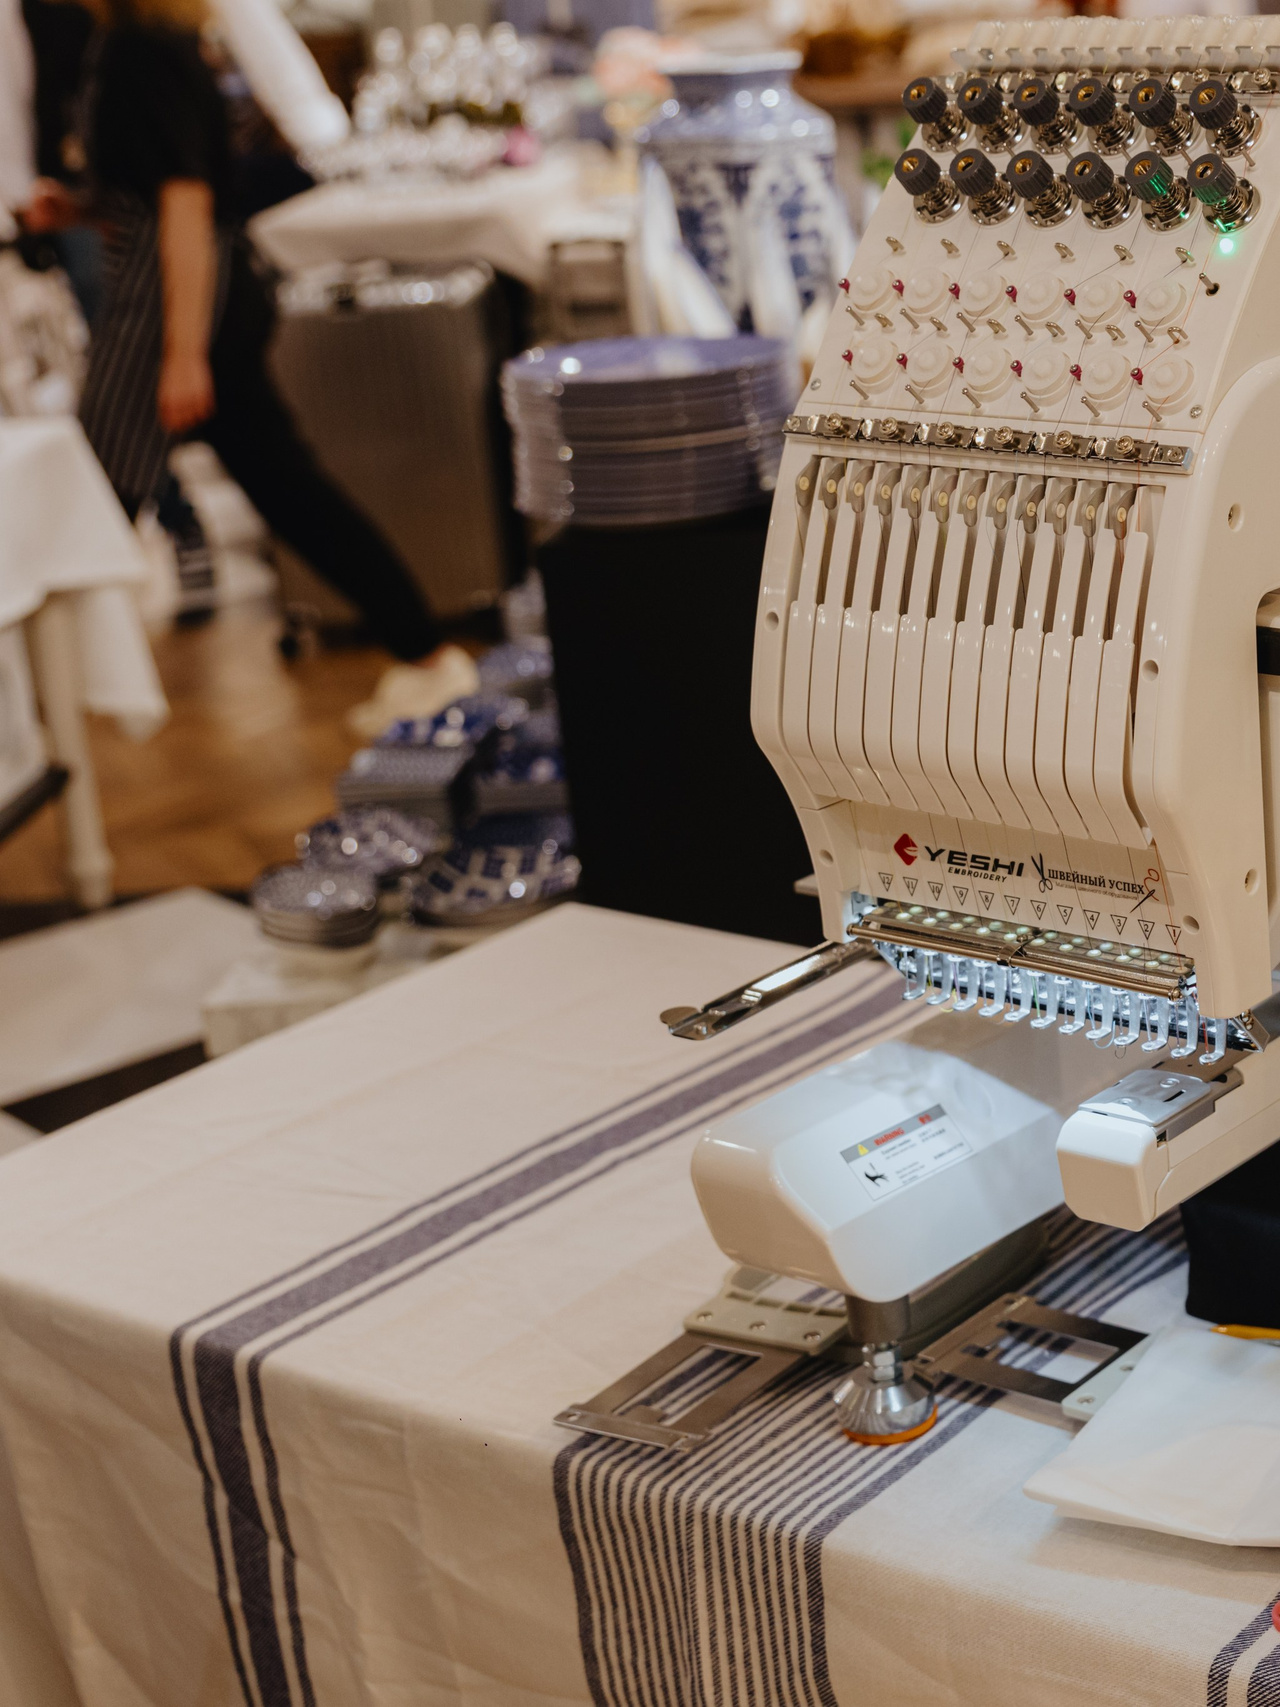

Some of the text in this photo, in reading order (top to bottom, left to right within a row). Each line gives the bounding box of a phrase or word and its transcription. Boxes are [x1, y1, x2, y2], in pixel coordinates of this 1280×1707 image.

[924, 846, 1024, 876] YESHI
[948, 867, 1008, 882] EMBROIDERY
[1048, 869, 1145, 894] ШВЕЙНЫЙ УСПЕХ
[1036, 904, 1042, 912] 6
[1063, 909, 1068, 917] 5
[1117, 918, 1122, 928] 3
[1144, 924, 1150, 932] 2
[874, 1128, 906, 1146] WARNING
